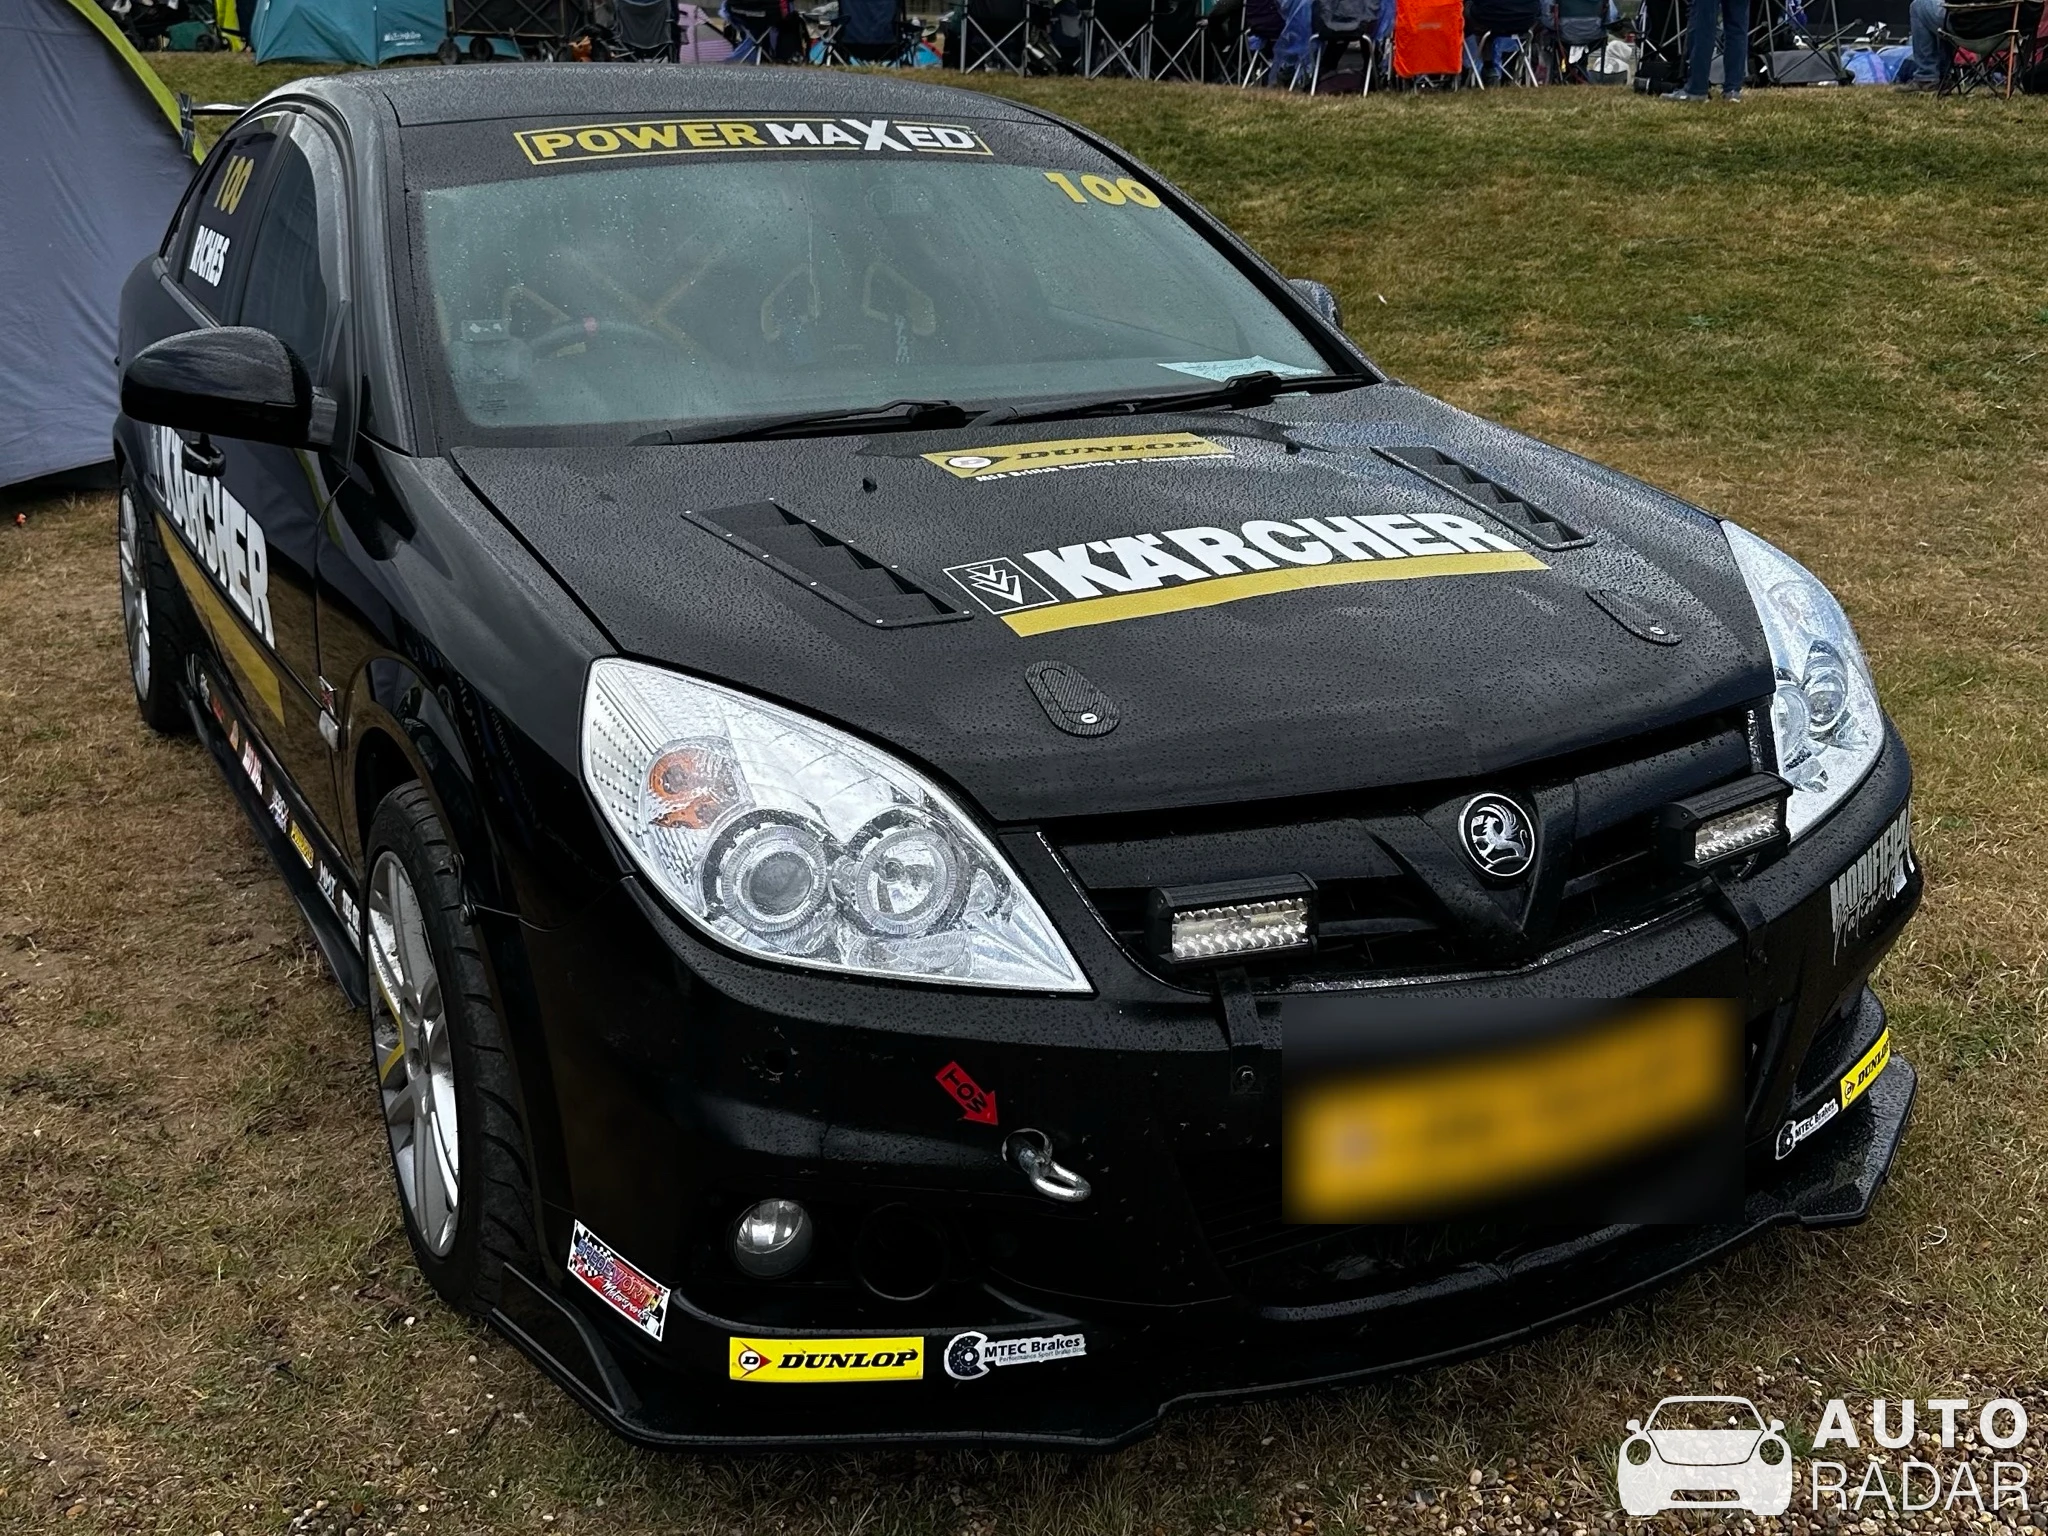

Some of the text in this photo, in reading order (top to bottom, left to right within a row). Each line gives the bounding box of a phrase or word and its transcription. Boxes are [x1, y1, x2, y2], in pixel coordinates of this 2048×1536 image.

[213, 155, 255, 216] 100
[1042, 172, 1162, 209] 100
[189, 224, 231, 287] RICHES
[1016, 440, 1205, 461] DUNLOP
[1023, 512, 1523, 599] KÄRCHER
[942, 1067, 988, 1115] TOW
[1795, 1116, 1815, 1139] MTEC
[777, 1348, 919, 1369] DUNLOP
[984, 1337, 1080, 1358] MTEC Brakes
